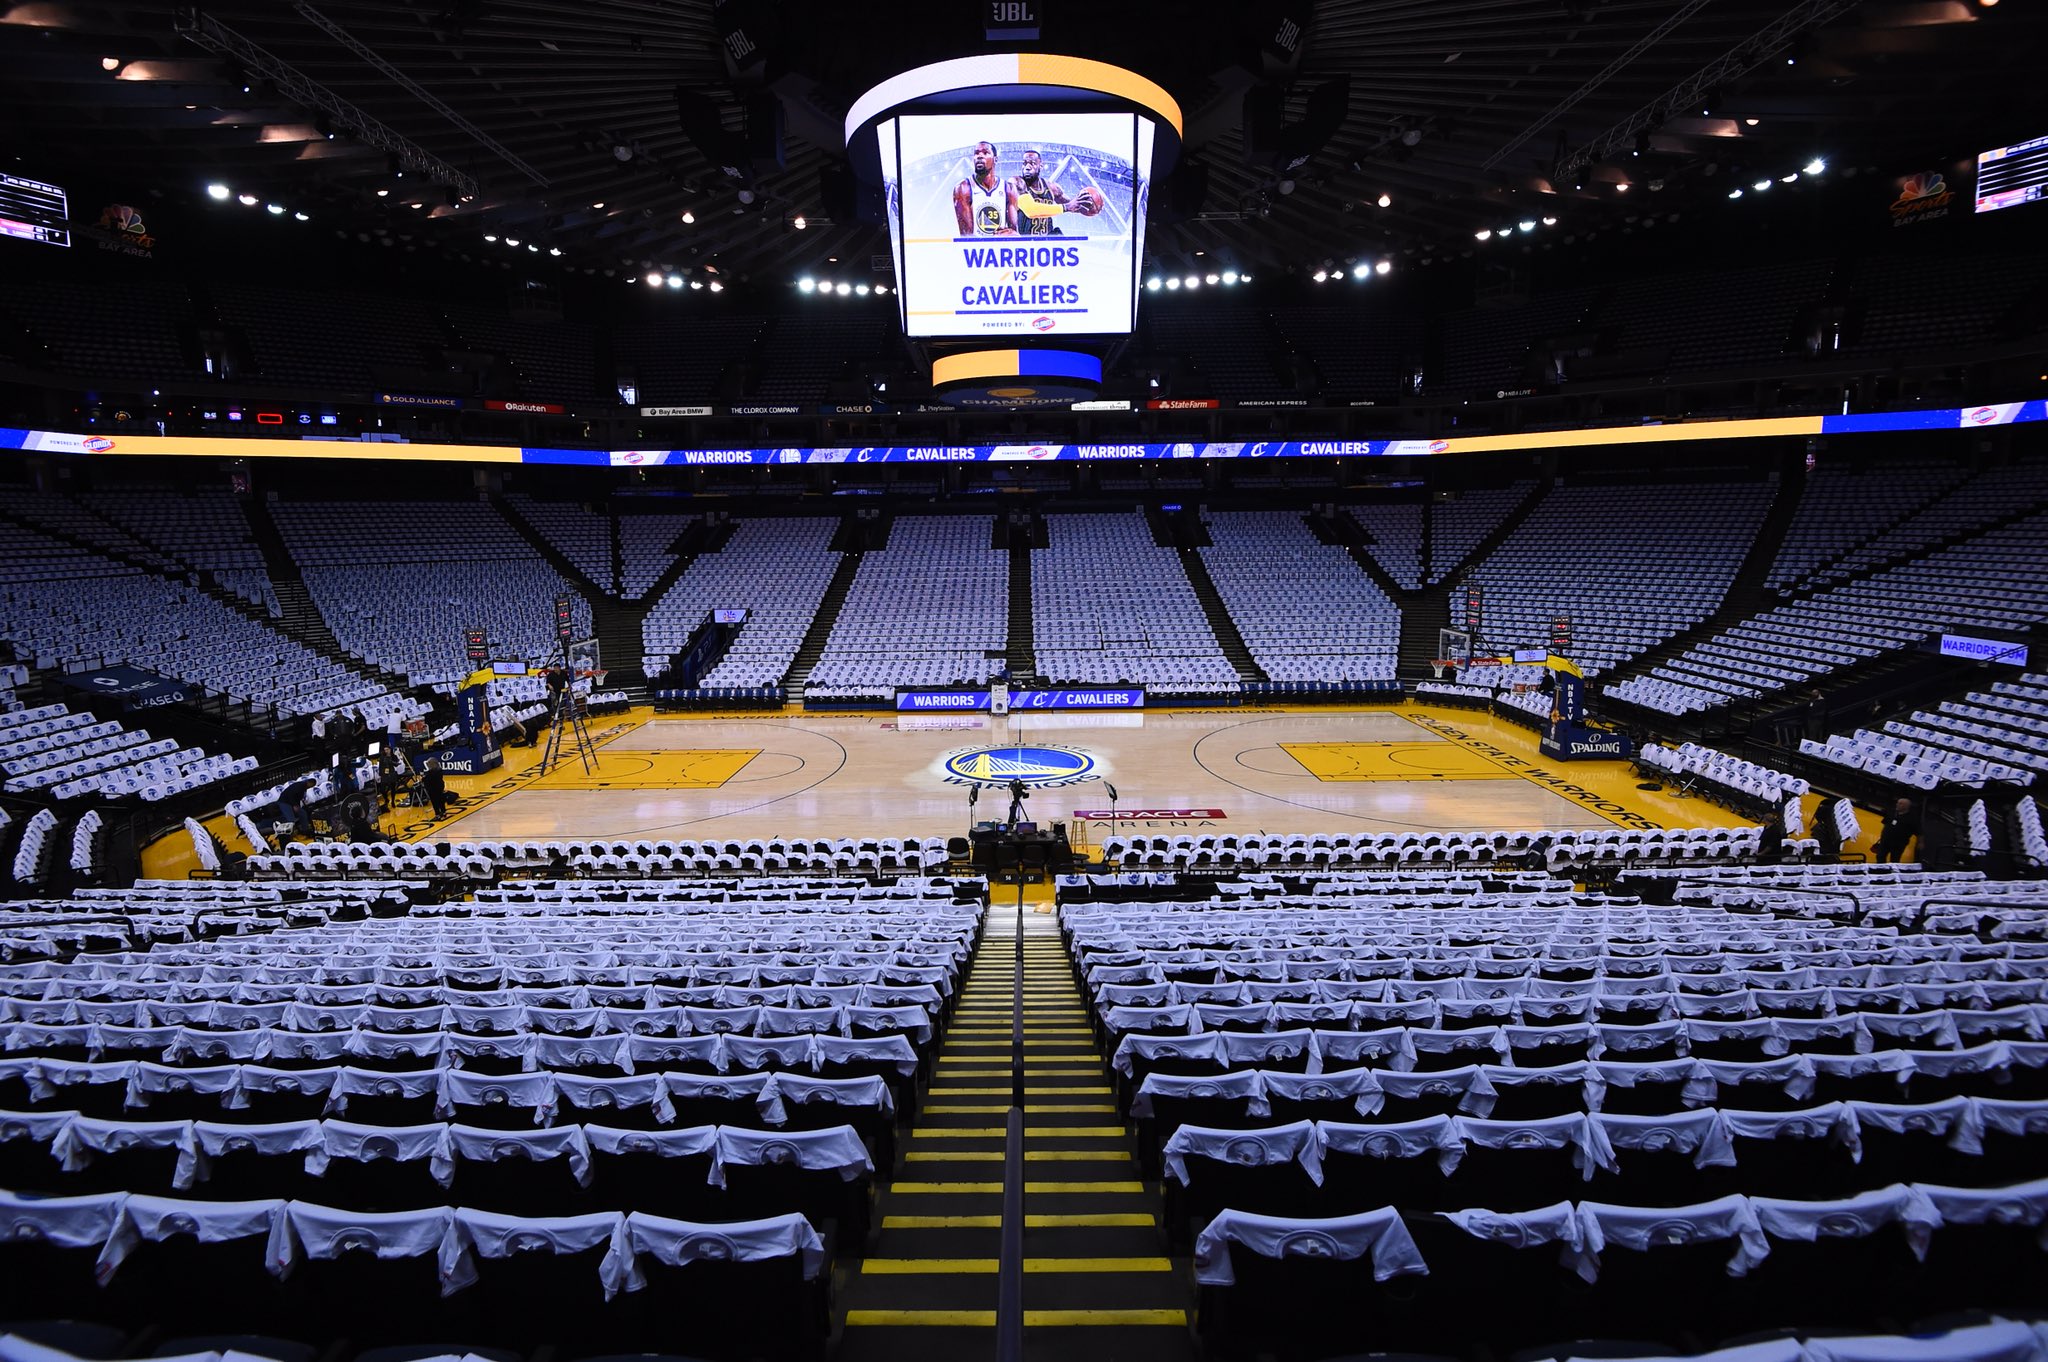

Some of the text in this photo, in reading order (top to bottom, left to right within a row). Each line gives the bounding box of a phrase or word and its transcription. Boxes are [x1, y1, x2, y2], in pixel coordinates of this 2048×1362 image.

[992, 2, 1034, 22] JBL
[1275, 17, 1300, 52] JBL
[725, 28, 756, 60] JBL
[988, 210, 998, 219] 35
[1031, 217, 1049, 235] 23
[963, 247, 1079, 268] WARRIORS
[1013, 270, 1028, 281] VS
[962, 285, 1079, 305] CAVALIERS
[392, 396, 456, 406] GOLD ALLIANCE
[511, 402, 547, 413] Rakuten
[658, 408, 673, 416] Bay
[769, 406, 799, 414] COMPANY
[84, 439, 112, 450] CLOROX
[1217, 446, 1227, 455] VS
[1300, 441, 1370, 455] CAVALIERS
[685, 451, 753, 464] WARRIORS
[824, 452, 834, 460] VS
[906, 448, 976, 461] CAVALIERS
[1077, 446, 1145, 459] WARRIORS
[913, 694, 974, 706] WARRIORS
[1066, 693, 1129, 705] CAVALIERS
[467, 697, 476, 734] NBA TV
[1567, 706, 1574, 721] TV
[948, 742, 1092, 755] GOLDEN STATE
[1570, 741, 1620, 754] SPALDING
[423, 758, 472, 773] SALDING
[1408, 712, 1470, 741] GOLDEN
[1465, 741, 1532, 767] STATE
[1524, 767, 1664, 831] WARRIORS
[394, 791, 500, 842] GODEN
[1088, 810, 1211, 819] ORACLE
[1093, 820, 1217, 829] ARENA
